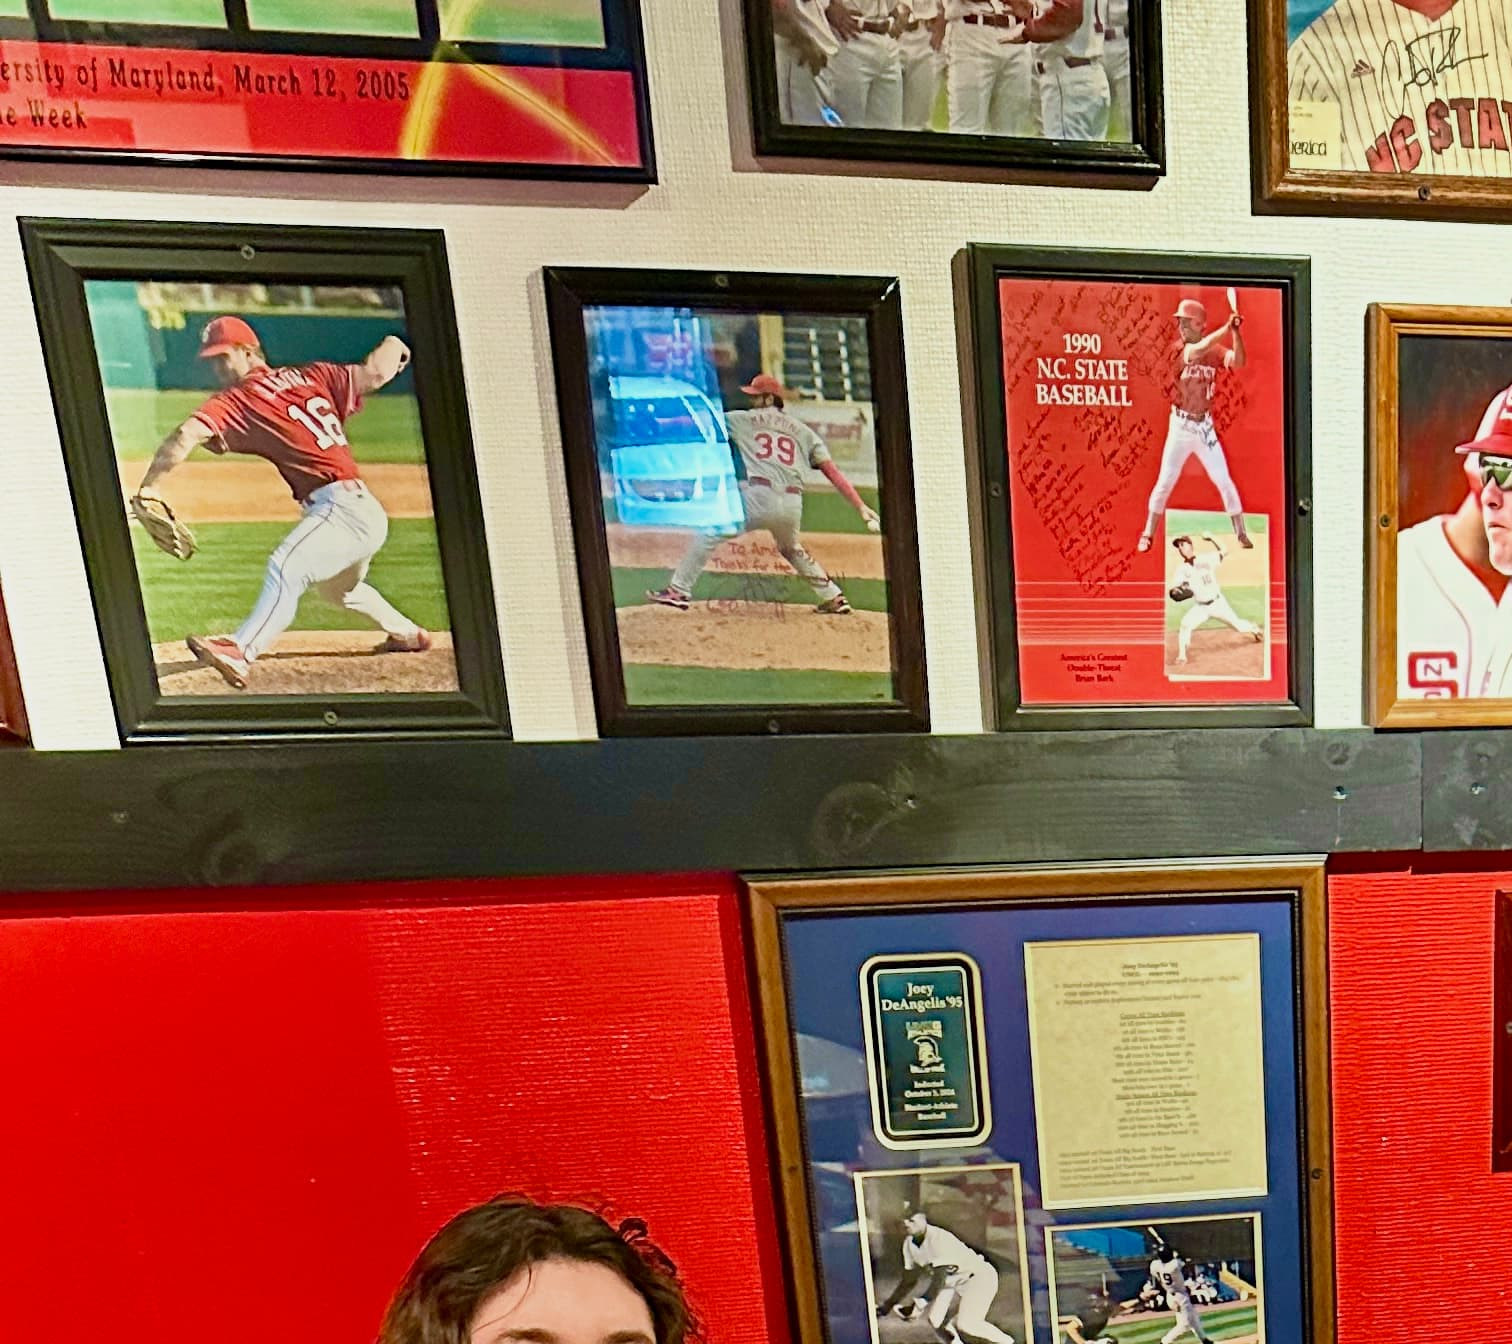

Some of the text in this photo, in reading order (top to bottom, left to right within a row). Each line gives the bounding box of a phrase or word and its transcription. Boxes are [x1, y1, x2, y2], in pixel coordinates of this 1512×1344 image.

[0, 57, 409, 102] ersity of Maryland, March 12, 2005
[27, 98, 87, 129] Week
[1062, 333, 1101, 355] 1990
[1037, 358, 1129, 381] N.C. STATE
[1036, 384, 1132, 407] BASEBALL
[287, 395, 349, 451] 16
[754, 432, 795, 466] 39
[907, 982, 935, 997] Joey
[1155, 1269, 1173, 1287] 19
